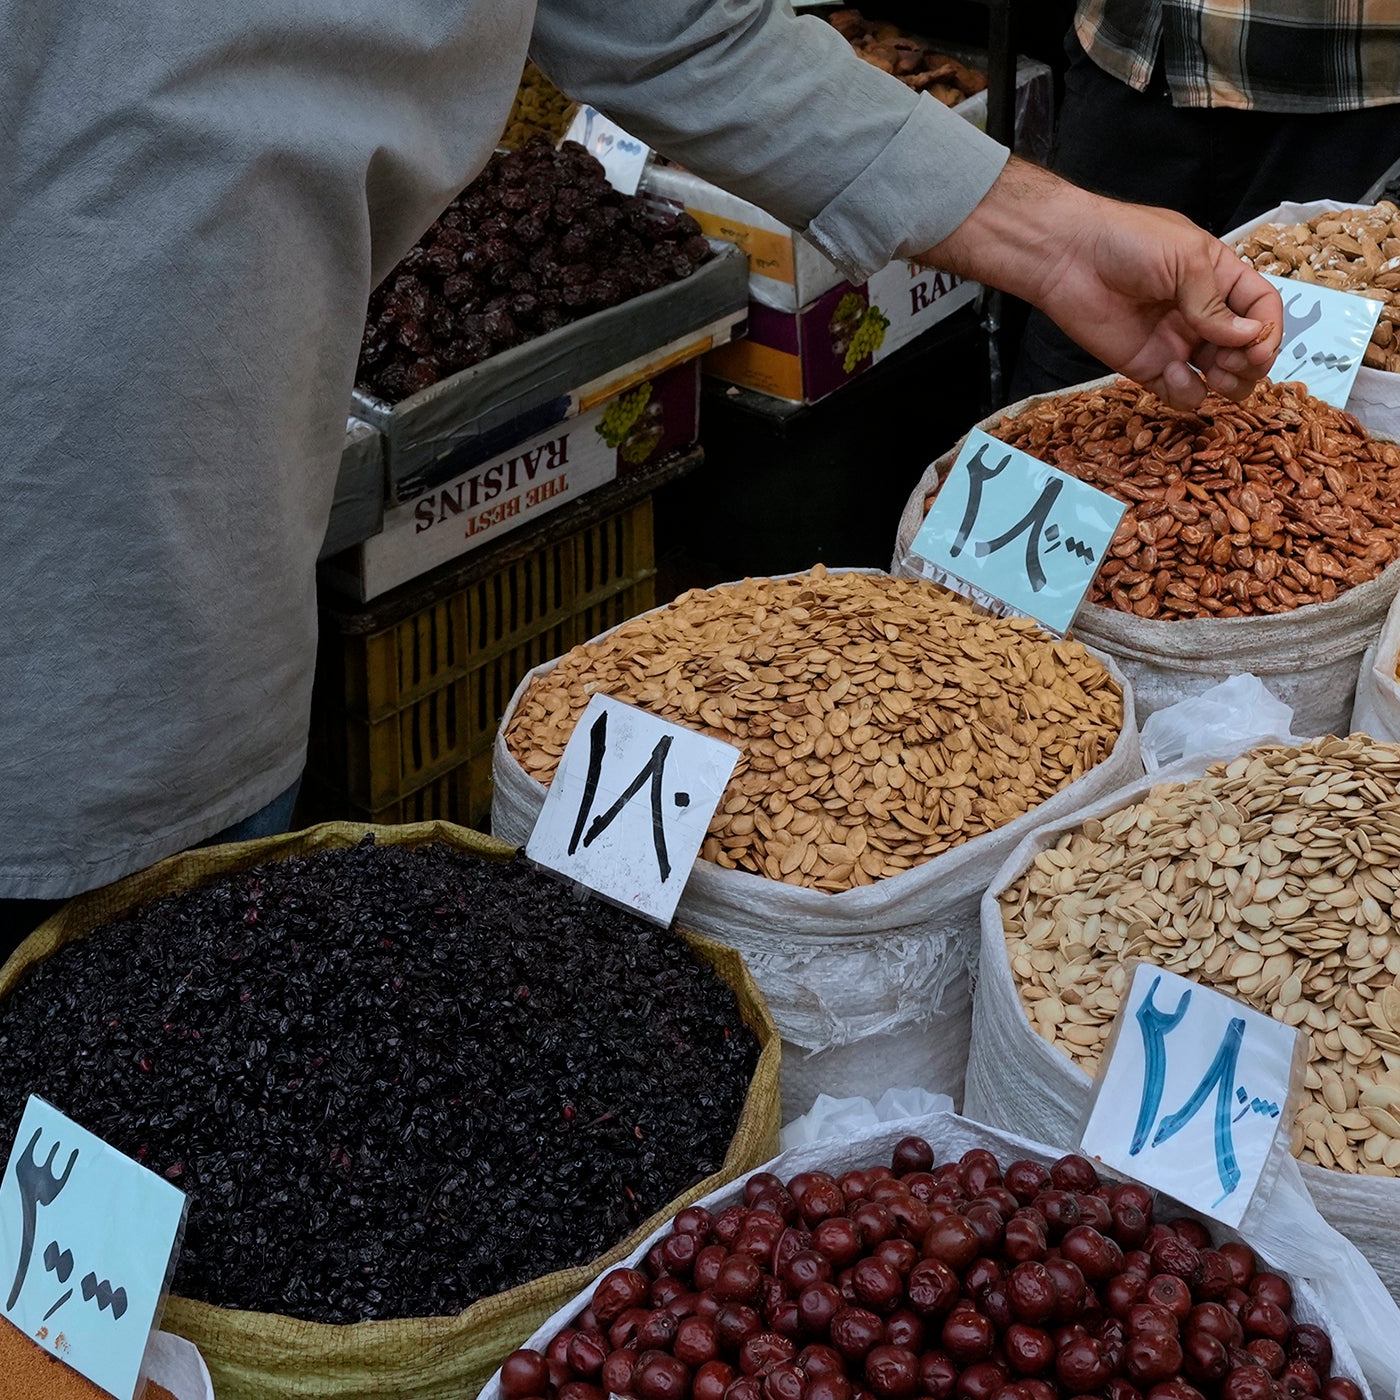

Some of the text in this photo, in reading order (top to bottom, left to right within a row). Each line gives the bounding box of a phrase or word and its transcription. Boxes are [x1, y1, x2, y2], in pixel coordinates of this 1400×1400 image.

[415, 433, 570, 534] RAISINS
[465, 473, 569, 539] THE BEST
